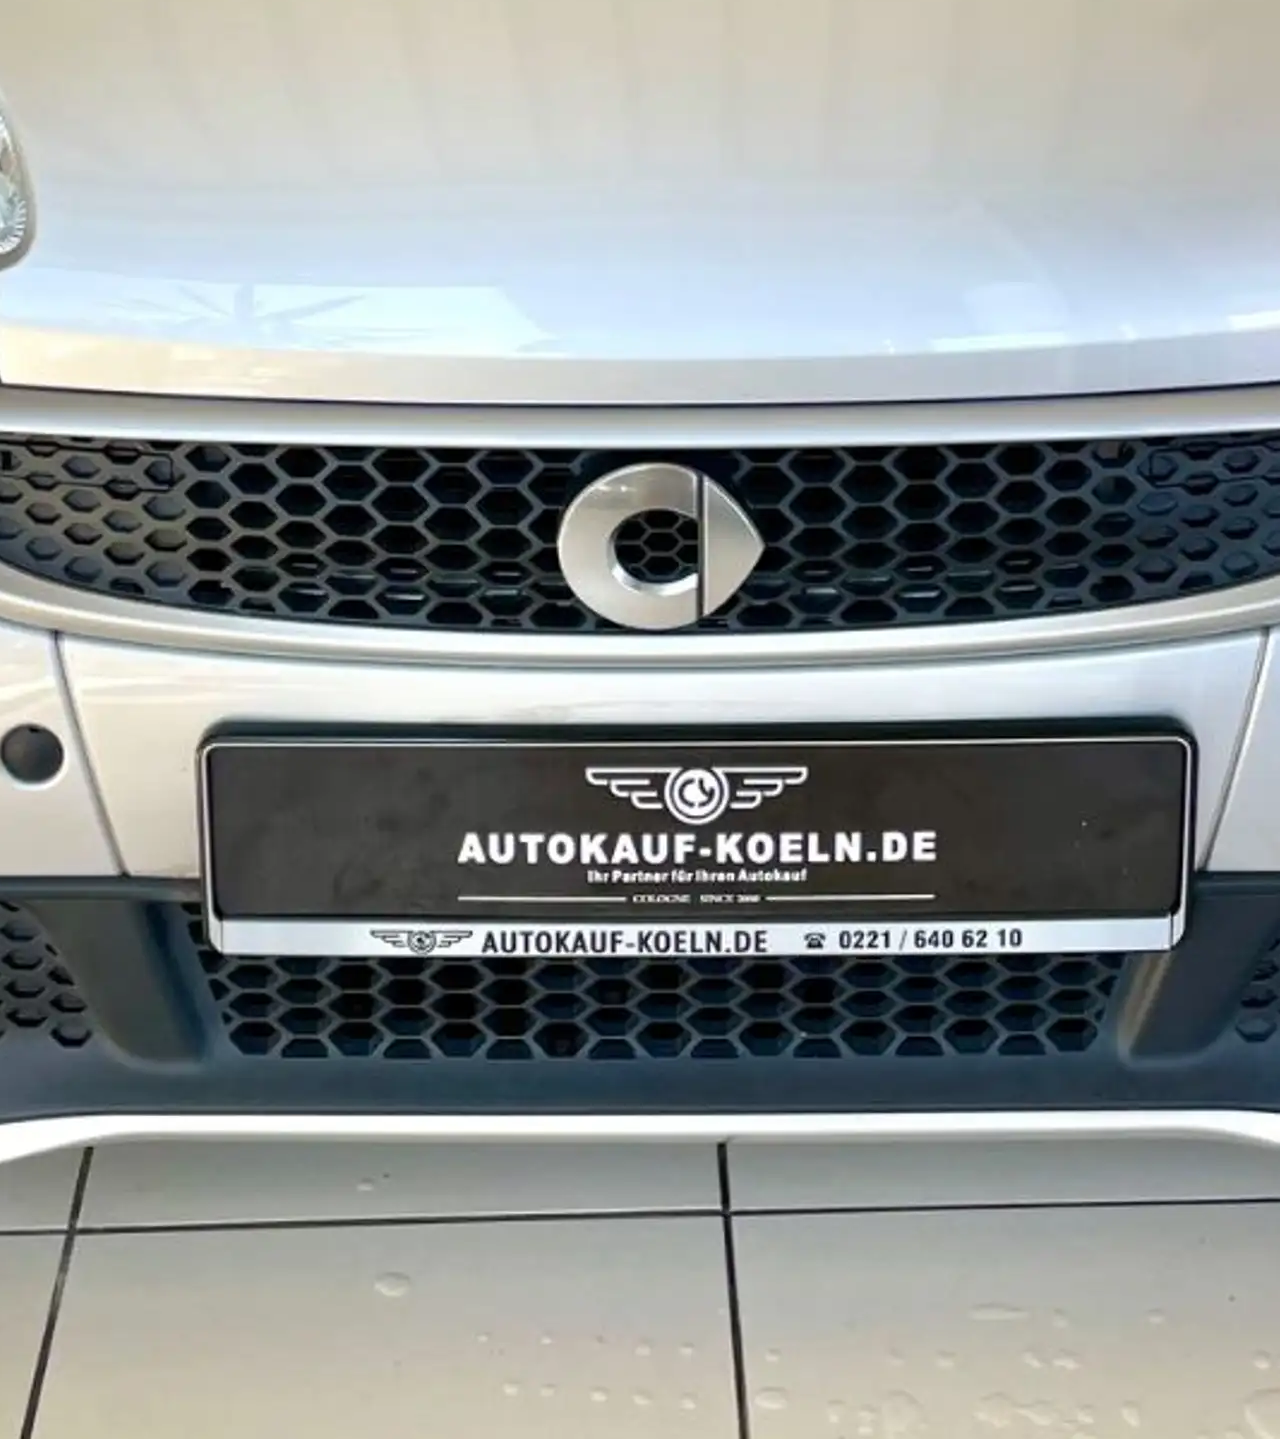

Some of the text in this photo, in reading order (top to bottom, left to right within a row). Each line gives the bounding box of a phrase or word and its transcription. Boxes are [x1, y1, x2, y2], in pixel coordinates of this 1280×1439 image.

[457, 831, 938, 864] AUTOKAUF-KOELN.DE
[587, 868, 808, 883] Ihr Partner für Ihren Autokauf
[481, 928, 1023, 954] AUTOKAUF-KOELN.DE 0221 / 640 62 10
